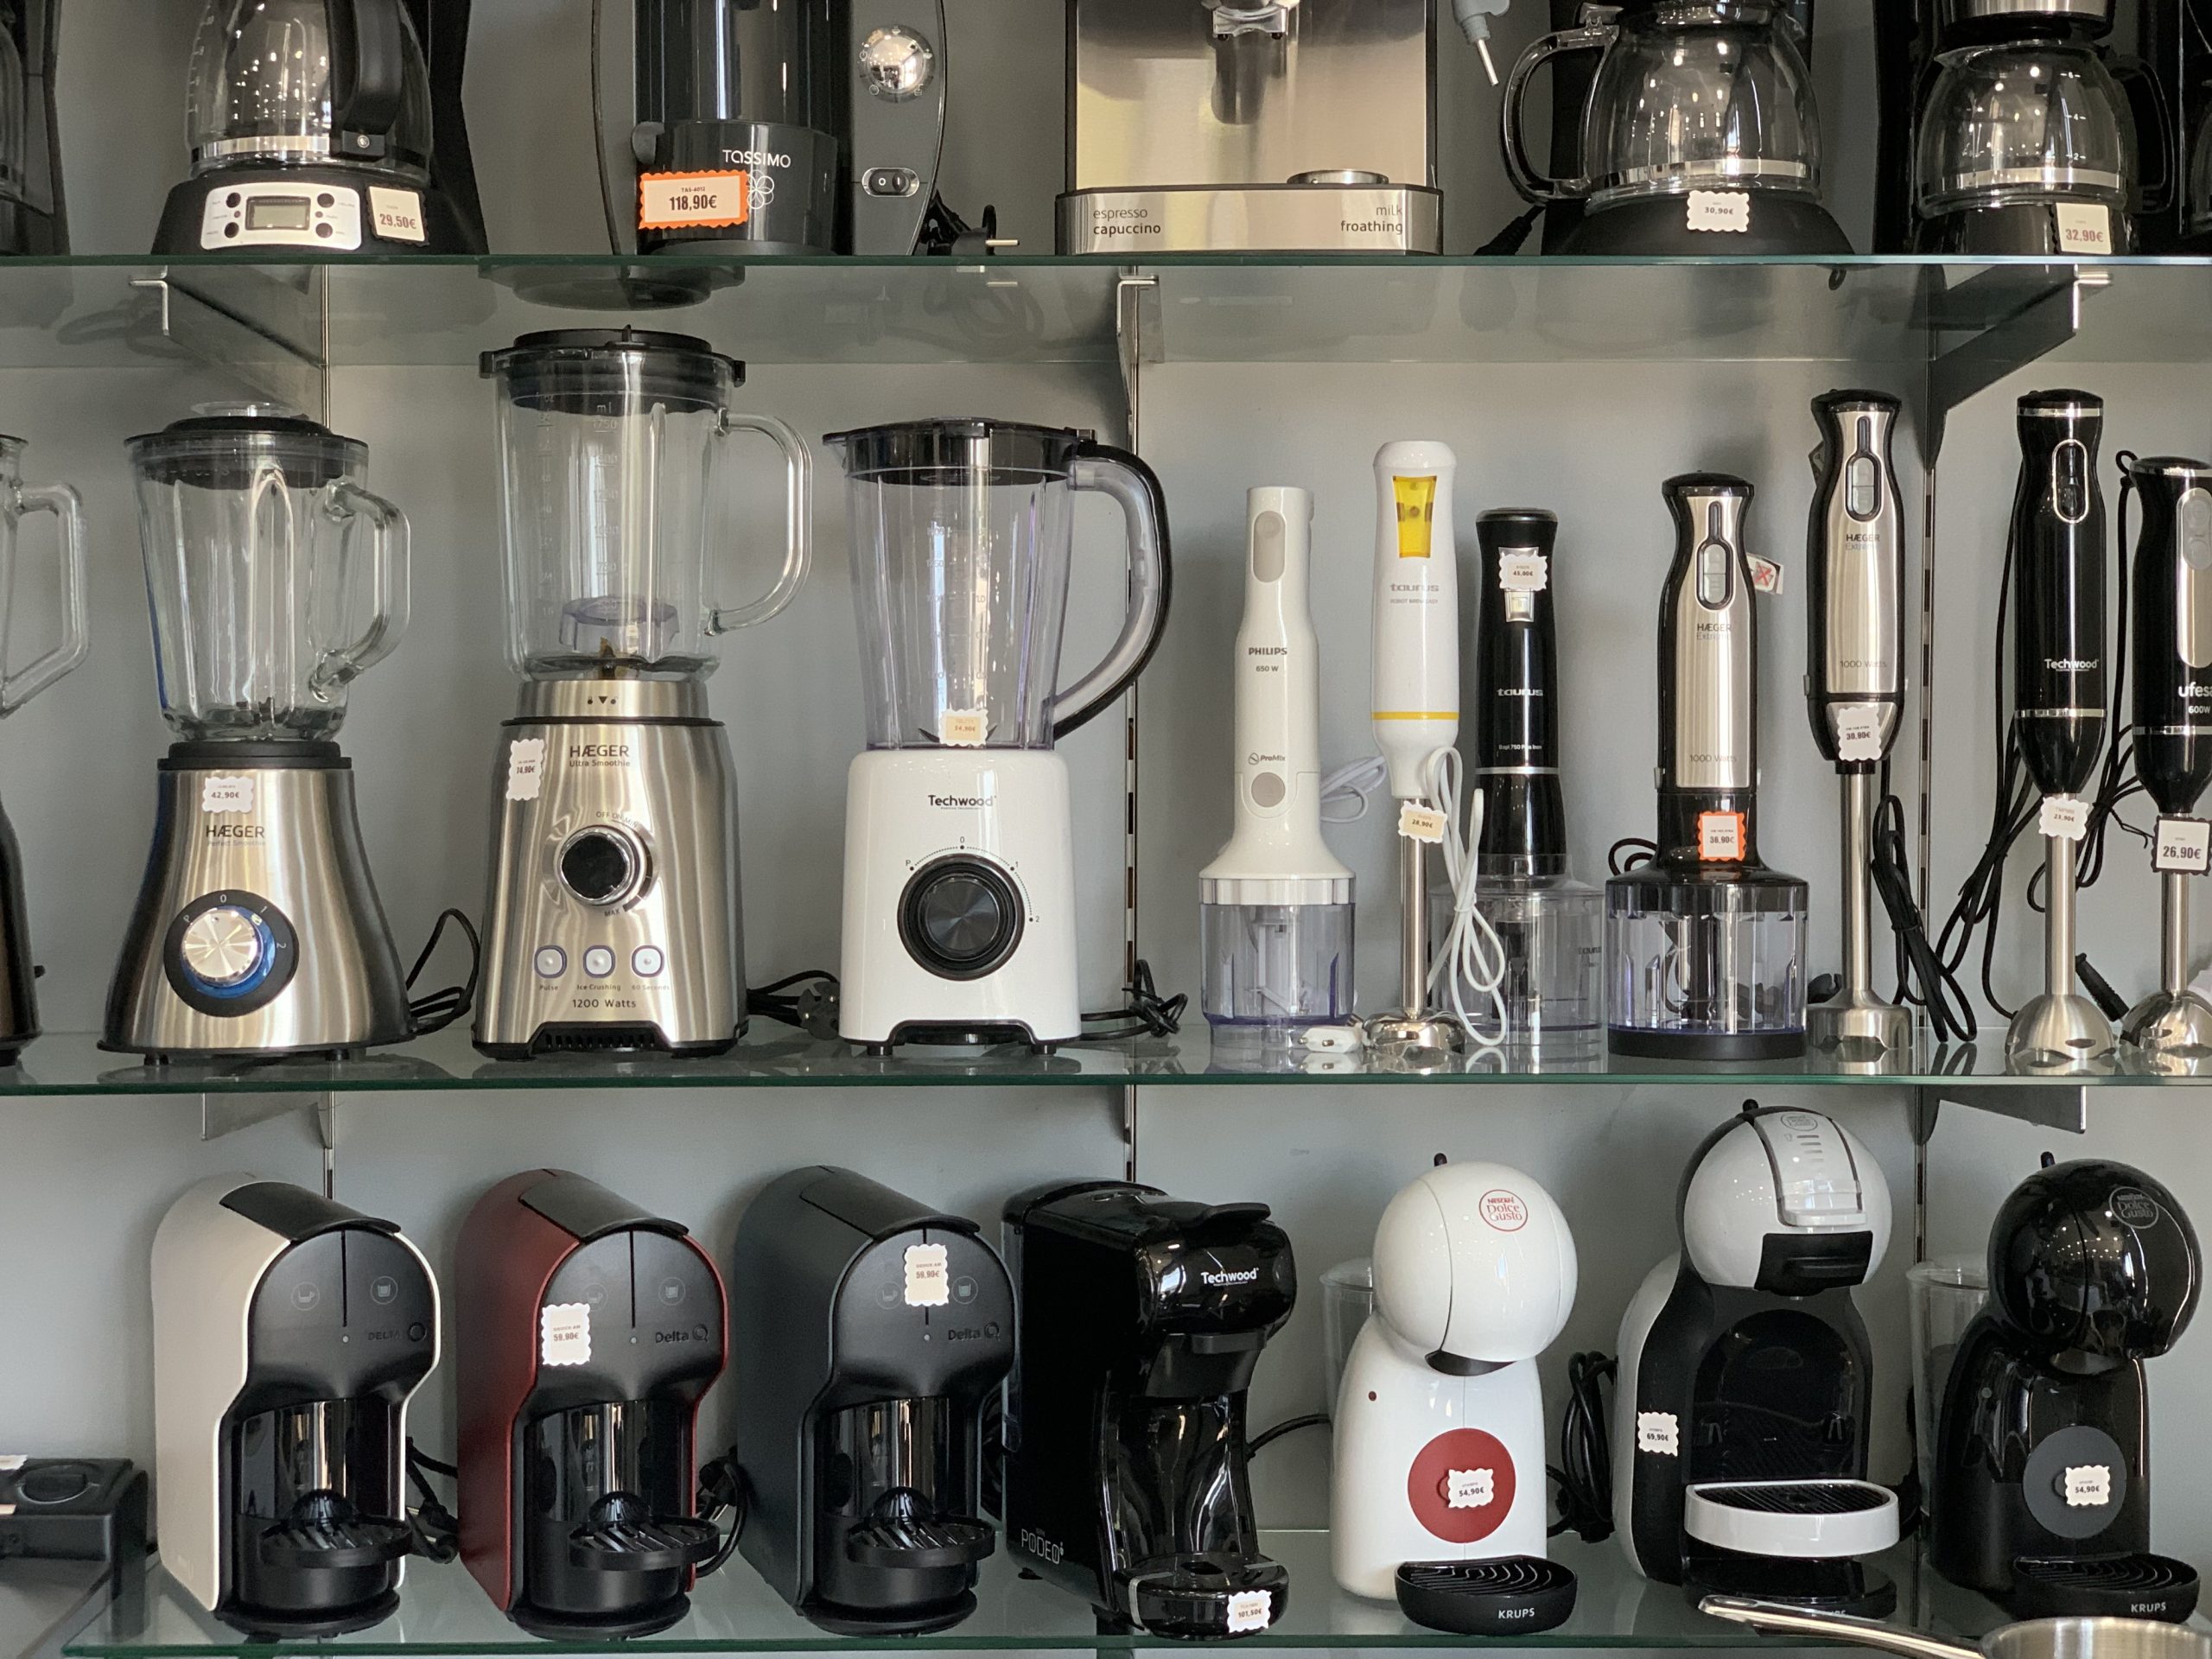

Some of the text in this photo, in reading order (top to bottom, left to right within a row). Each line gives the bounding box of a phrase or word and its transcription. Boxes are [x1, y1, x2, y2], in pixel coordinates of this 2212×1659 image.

[722, 149, 791, 168] TASSIMO
[670, 194, 717, 212] 118,90€
[1093, 207, 1148, 221] espresso
[1376, 204, 1404, 217] milk
[379, 213, 416, 230] 29,50€
[1093, 222, 1161, 238] capuccino
[1340, 219, 1404, 236] froathing
[2065, 228, 2103, 243] 32,90€
[1248, 646, 1287, 656] PHILIPS
[2044, 658, 2097, 669] Techwood
[2188, 705, 2211, 714] 600W
[1689, 753, 1713, 762] 1000
[211, 791, 240, 800] 42,90€
[928, 795, 994, 806] Techwood
[2163, 845, 2202, 860] 26,90€
[604, 908, 621, 917] MAX
[588, 983, 621, 992] Crushing
[572, 999, 637, 1008] 1200 Watts
[1486, 1203, 1520, 1213] Dolce
[1489, 1211, 1522, 1221] Gusto
[1200, 1268, 1257, 1284] Techwood
[655, 1331, 690, 1344] Delta
[948, 1329, 981, 1341] Delta
[1459, 1486, 1484, 1497] 54,90€
[2075, 1484, 2100, 1494] 54,90€
[1497, 1607, 1535, 1618] KRUPS
[2131, 1601, 2166, 1613] KRUPS
